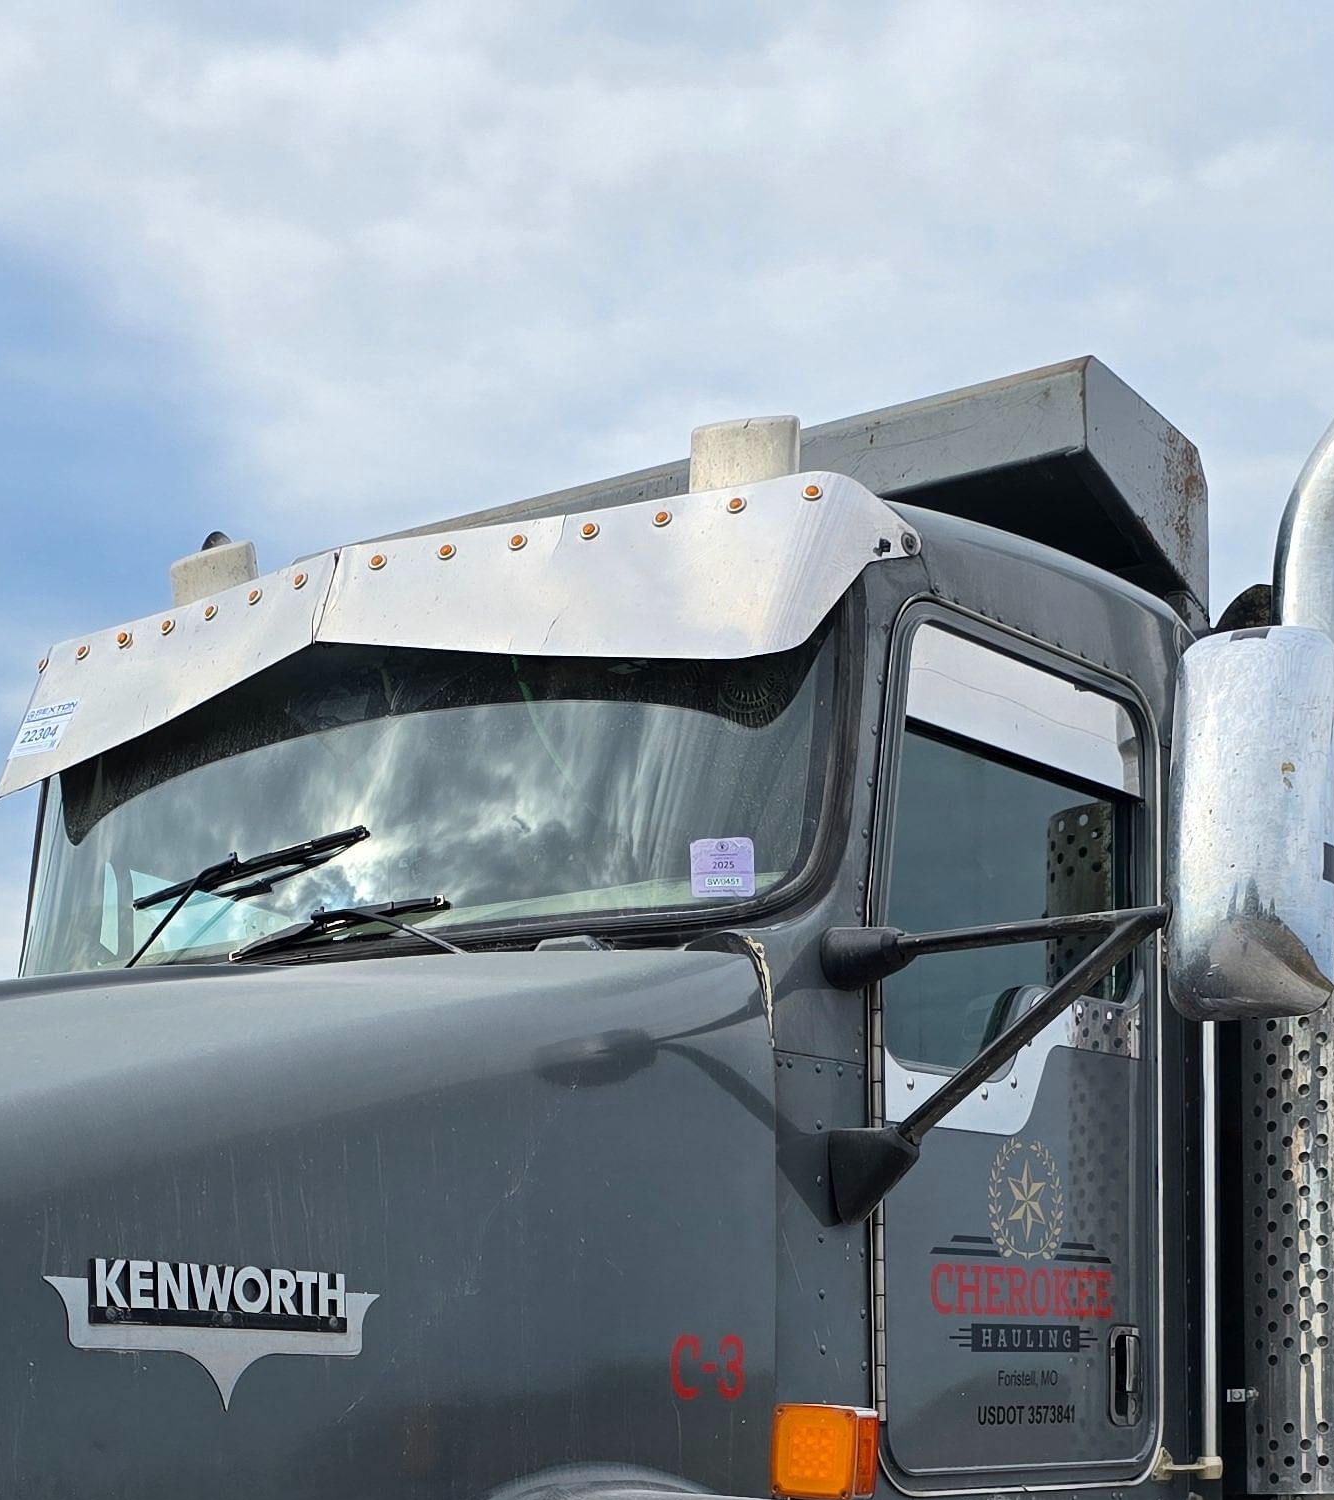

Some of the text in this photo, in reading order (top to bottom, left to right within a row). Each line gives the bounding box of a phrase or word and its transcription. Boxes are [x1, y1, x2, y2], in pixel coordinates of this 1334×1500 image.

[36, 701, 78, 715] SEXTON
[20, 725, 59, 744] 22304
[712, 861, 735, 870] 2025
[94, 1258, 347, 1318] KENWORTH
[930, 1263, 1115, 1319] CHEROKEE
[981, 1328, 1072, 1348] HAULING
[670, 1333, 745, 1400] C-3
[998, 1370, 1058, 1388] Foristell, MO
[978, 1404, 1075, 1425] USDOT 3573841
